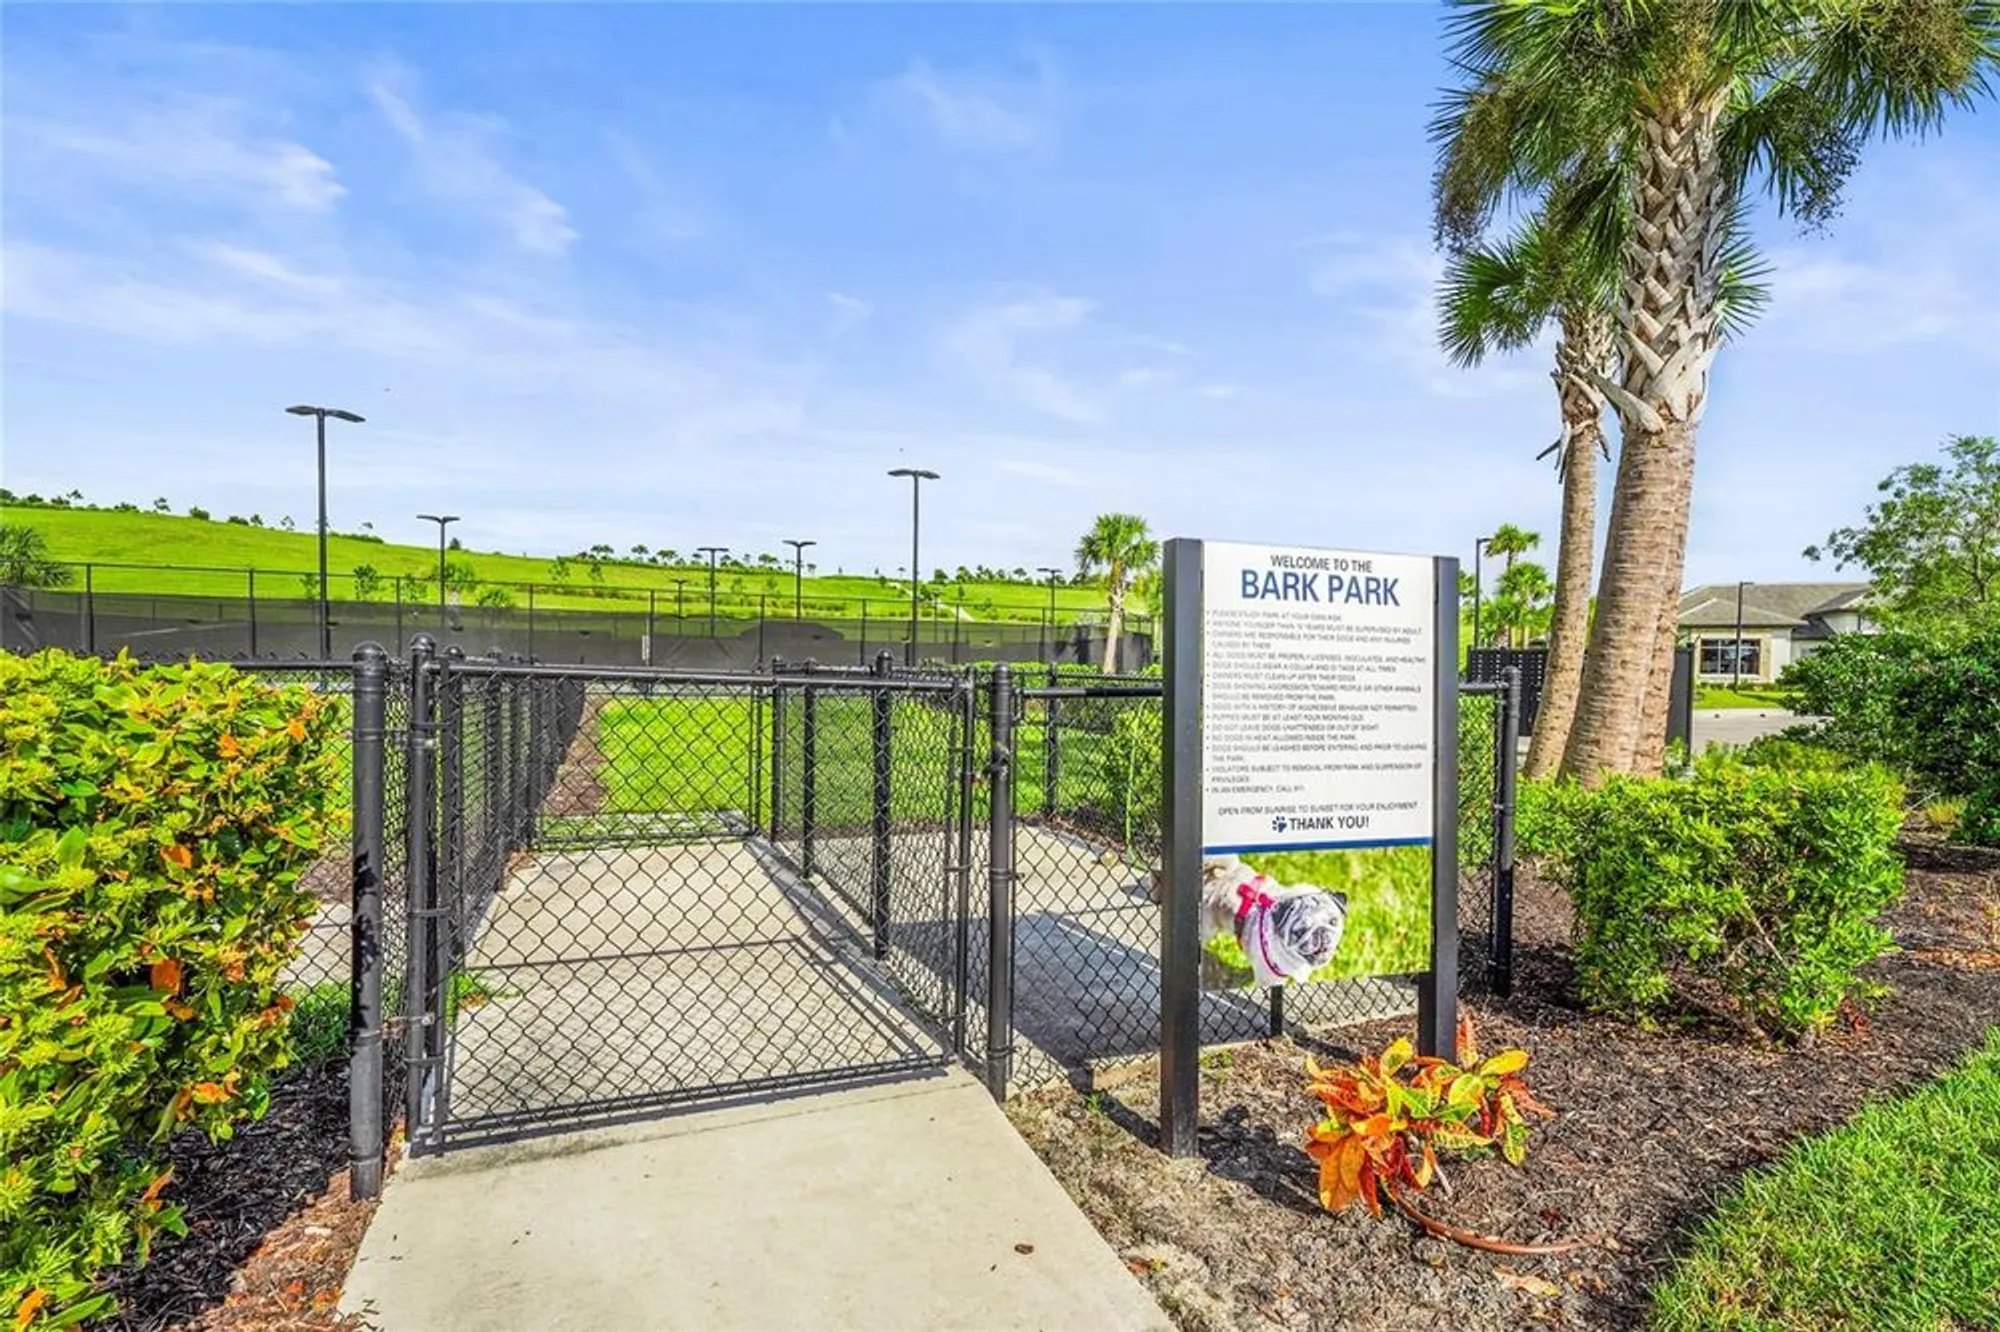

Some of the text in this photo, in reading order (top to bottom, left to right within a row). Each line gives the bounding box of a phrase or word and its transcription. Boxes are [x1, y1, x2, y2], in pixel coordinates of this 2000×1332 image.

[1270, 553, 1372, 573] WELCOME TO THE
[1241, 568, 1399, 606] BARK PARK
[1212, 619, 1240, 627] ANYONE
[1244, 621, 1274, 629] YOUNGER
[1355, 625, 1391, 633] SUPERVISED
[1212, 630, 1240, 638] OWNERS
[1258, 631, 1300, 640] RESPONSIBLE
[1316, 633, 1334, 641] THEIR
[1355, 634, 1368, 642] AND
[1384, 635, 1410, 643] INJURIES
[1212, 640, 1240, 648] CAUSED
[1212, 650, 1225, 658] ALL
[1247, 651, 1266, 659] MUST
[1278, 652, 1306, 660] PROPERLY
[1212, 661, 1231, 669] DOGS
[1234, 662, 1260, 670] SHOULD
[1262, 662, 1281, 670] WEAR
[1288, 663, 1314, 671] COLLAR
[1315, 663, 1328, 671] AND
[1338, 664, 1354, 672] TAGS
[1356, 664, 1364, 672] AT
[1212, 671, 1240, 679] OWNERS
[1212, 682, 1231, 690] DOGS
[1234, 682, 1265, 690] SHOWING
[1268, 683, 1309, 691] AGGRESSION
[1311, 683, 1337, 691] TOWARD
[1374, 684, 1392, 692] OTHER
[1251, 692, 1284, 700] REMOVED
[1212, 702, 1231, 710] DOGS
[1338, 703, 1368, 711] BEHAVIOR
[1212, 713, 1239, 721] PUPPIES
[1241, 713, 1260, 721] MUST
[1262, 713, 1269, 721] BE
[1272, 713, 1281, 721] AT
[1282, 713, 1301, 721] LEAST
[1303, 713, 1320, 721] FOUR
[1322, 713, 1349, 721] MONTHS
[1212, 723, 1221, 731] DO
[1223, 723, 1238, 731] NOT
[1240, 723, 1259, 731] LEAVE
[1262, 723, 1281, 731] DOGS
[1282, 723, 1325, 731] UNATTENDED
[1326, 723, 1335, 731] OR
[1337, 723, 1349, 731] OUT
[1350, 723, 1358, 731] OF
[1326, 733, 1338, 741] THE
[1212, 744, 1231, 752] DOGS
[1234, 744, 1260, 752] SHOULD
[1262, 744, 1269, 752] BE
[1271, 744, 1300, 752] LEASHED
[1327, 743, 1358, 751] ENTERING
[1359, 743, 1372, 751] AND
[1373, 743, 1391, 751] PRIOR
[1211, 764, 1248, 772] VIOLATORS
[1250, 764, 1280, 772] SUBJECT
[1292, 763, 1322, 771] REMOVAL
[1375, 762, 1412, 770] SUSPENSION
[1275, 784, 1292, 792] CALL
[1218, 801, 1417, 815] OPEN FROM SUNRISE TO SUNSET FOR YOUR ENJOYMENT
[1288, 815, 1369, 830] THANK YOU!
